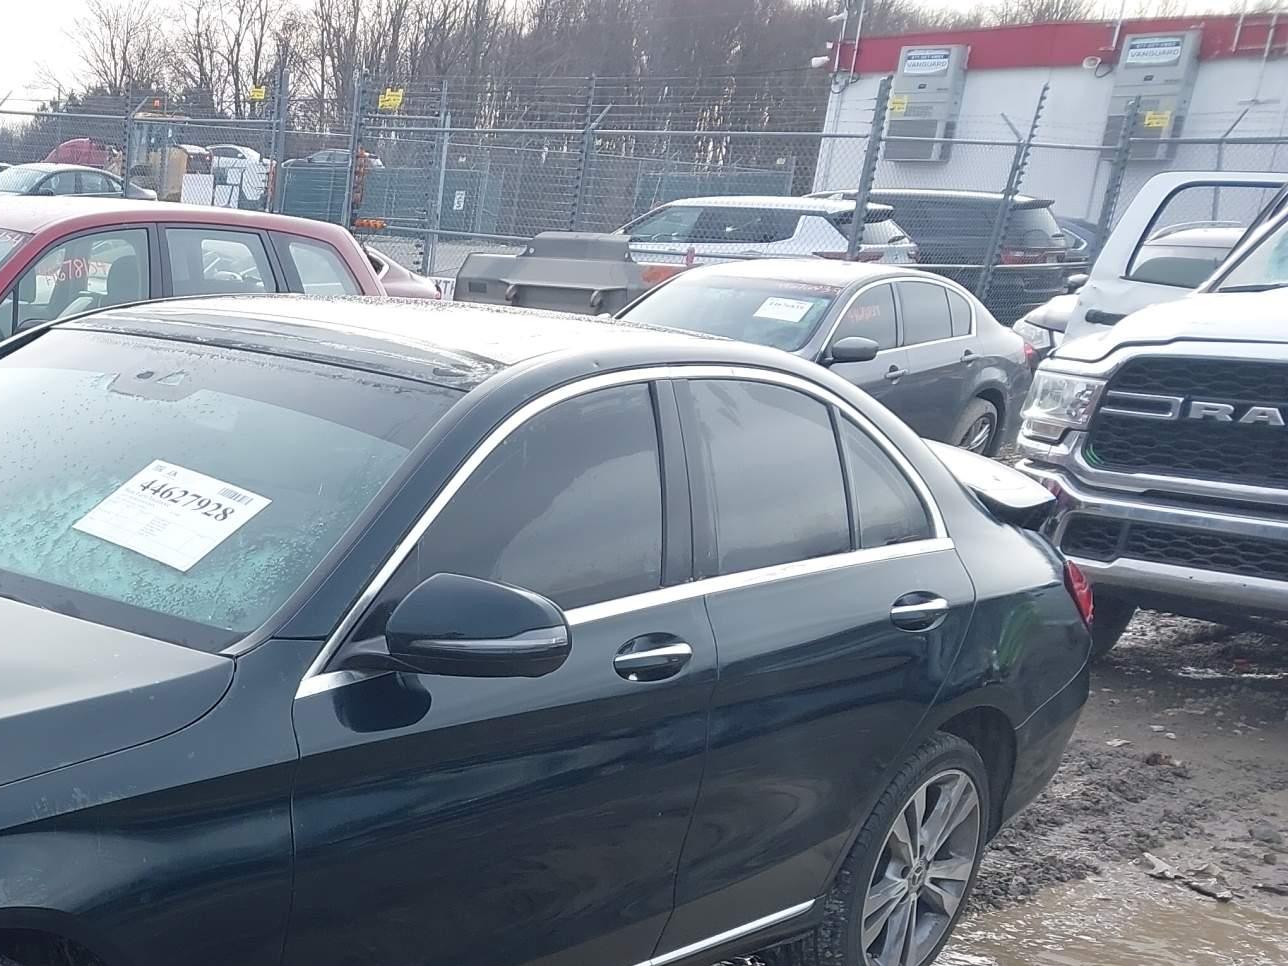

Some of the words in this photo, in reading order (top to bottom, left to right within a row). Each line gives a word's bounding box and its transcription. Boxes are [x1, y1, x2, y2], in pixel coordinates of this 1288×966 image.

[906, 60, 947, 68] VANGUARD
[1188, 401, 1285, 426] RA
[140, 480, 235, 522] 44627928
